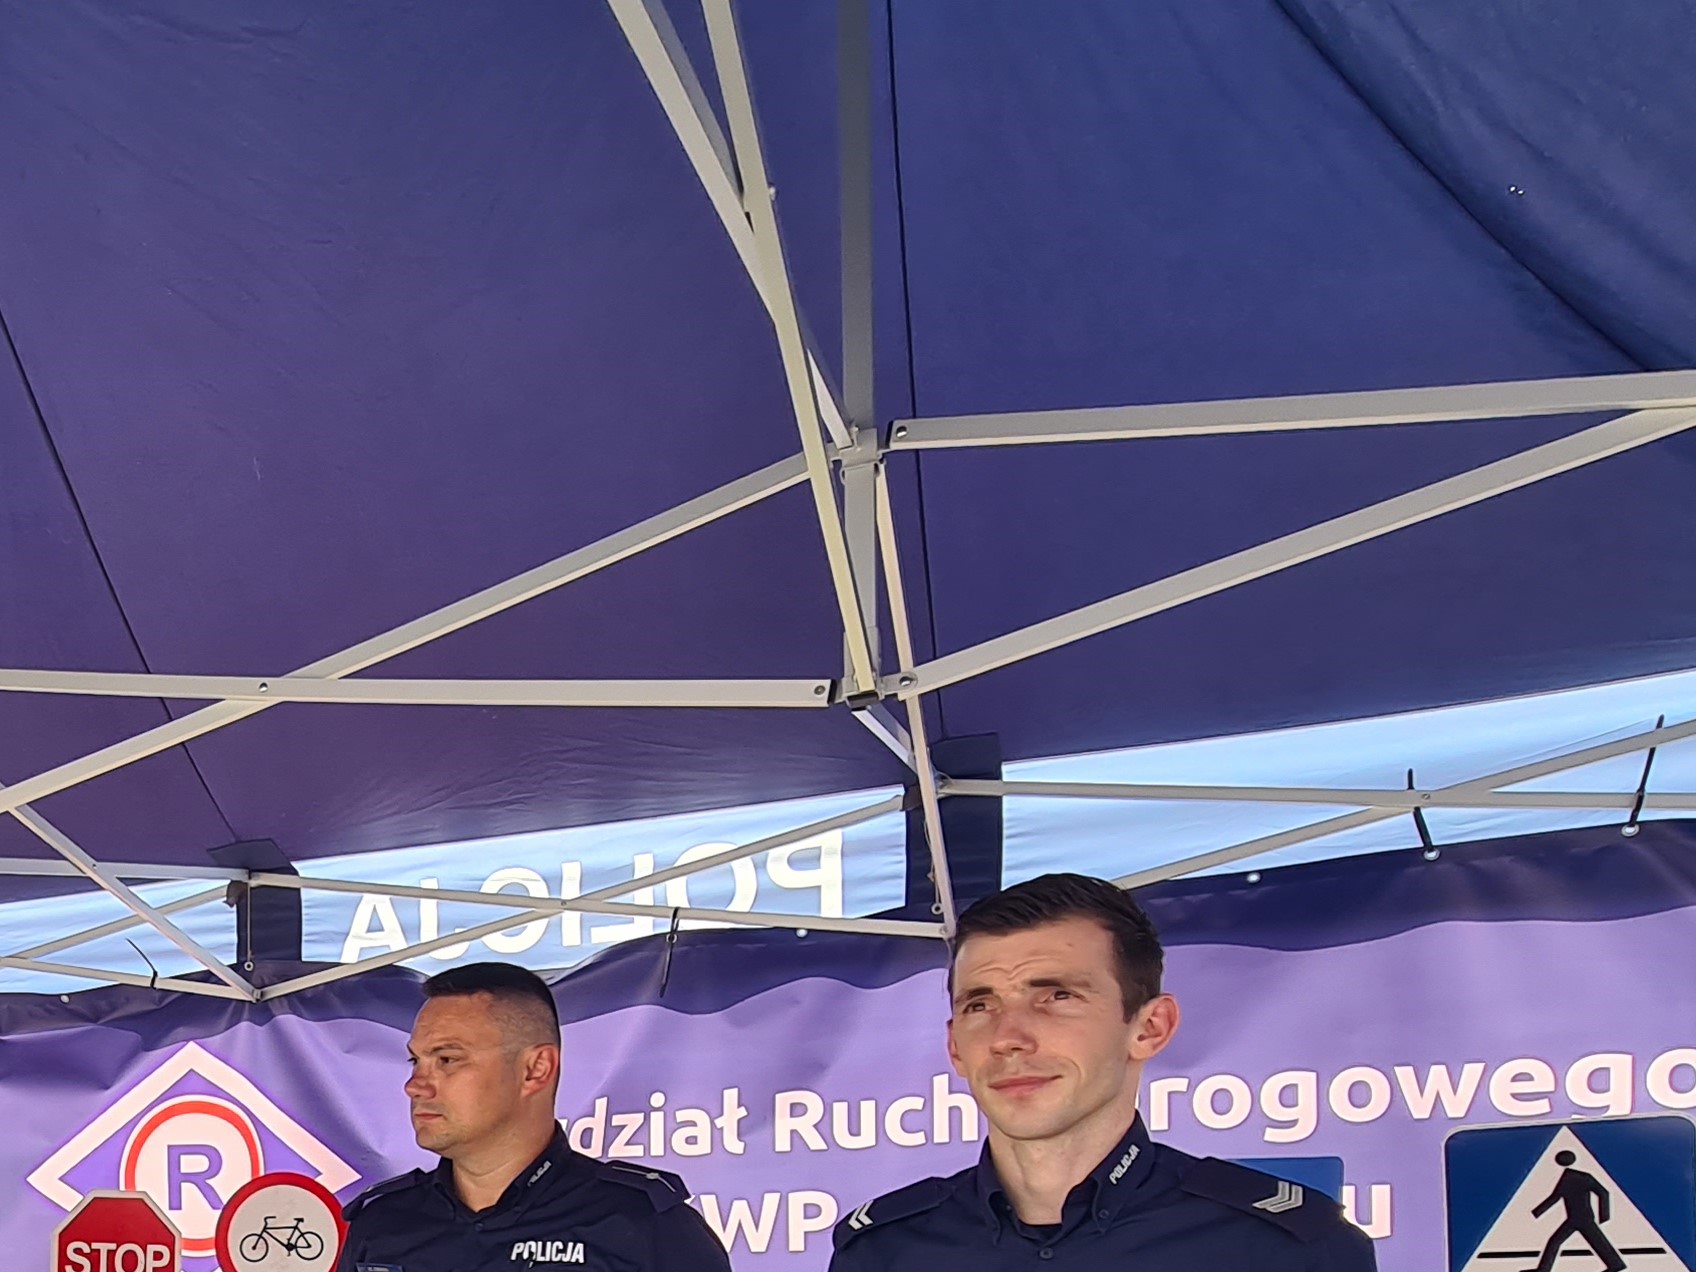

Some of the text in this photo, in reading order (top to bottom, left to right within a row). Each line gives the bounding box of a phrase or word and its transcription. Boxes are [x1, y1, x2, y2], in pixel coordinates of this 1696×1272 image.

[557, 1047, 1696, 1159] dział Ruch rogowego
[167, 1144, 224, 1210] R
[1109, 1144, 1141, 1184] POLICJA
[510, 1240, 585, 1264] POLICJA
[684, 1190, 839, 1253] WP
